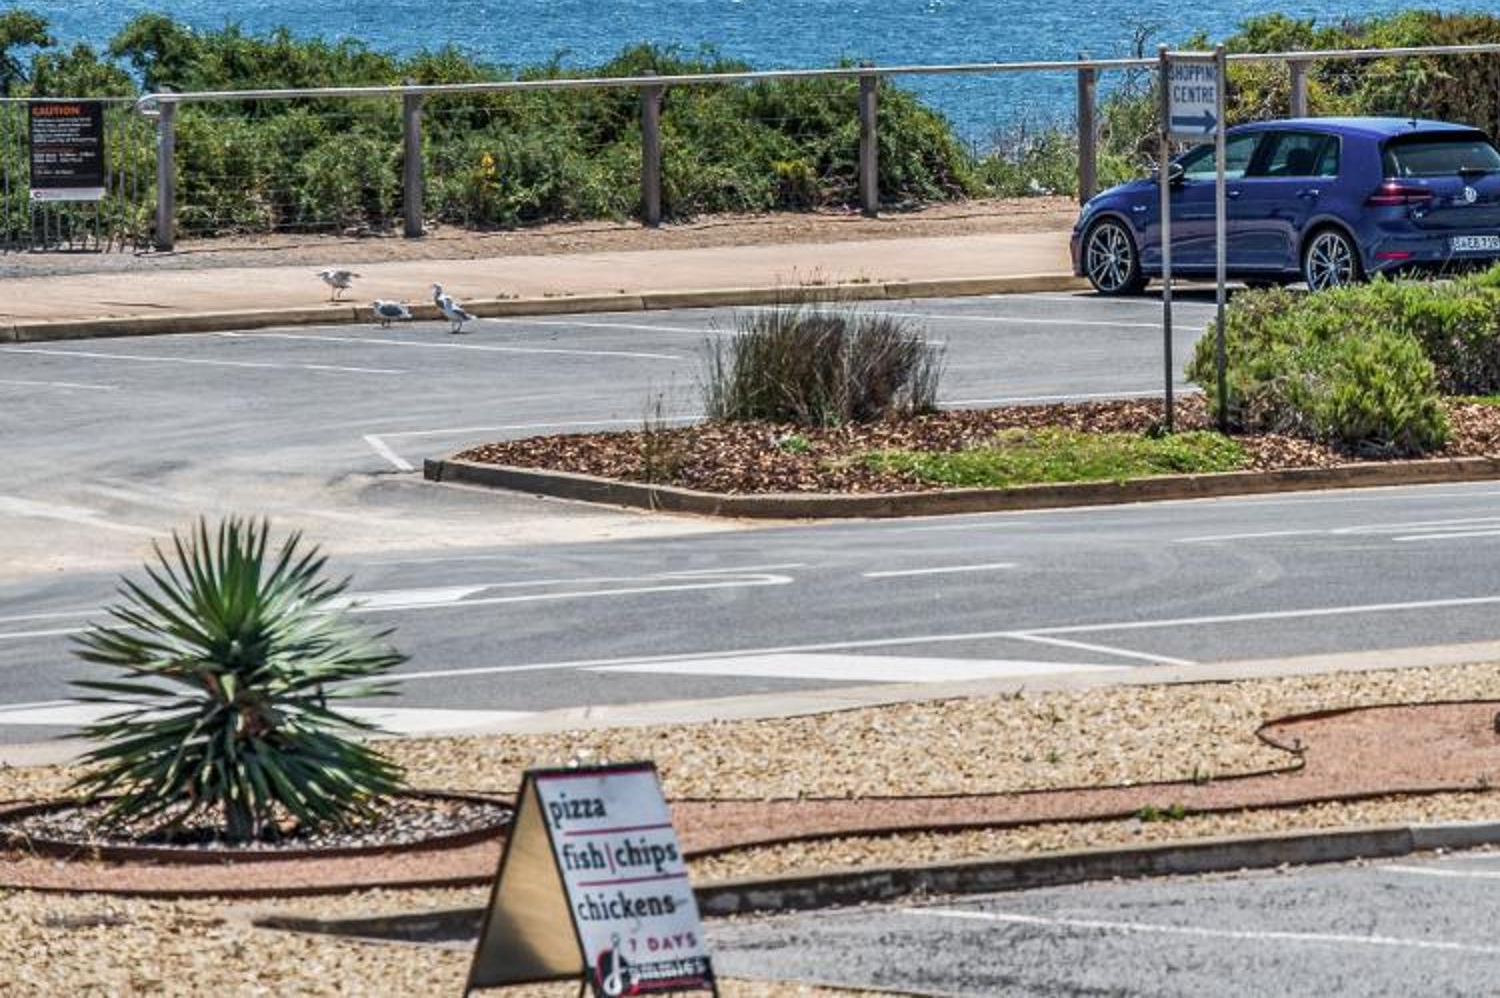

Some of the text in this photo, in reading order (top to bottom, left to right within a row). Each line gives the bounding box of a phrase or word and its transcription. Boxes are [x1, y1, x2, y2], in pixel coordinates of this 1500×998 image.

[1168, 65, 1217, 82] SHOPPIN
[1173, 85, 1215, 103] CENTRE
[32, 106, 80, 116] CAUTION
[548, 793, 607, 829] pizza
[577, 892, 677, 921] chickens
[629, 932, 697, 952] 7 DAYS
